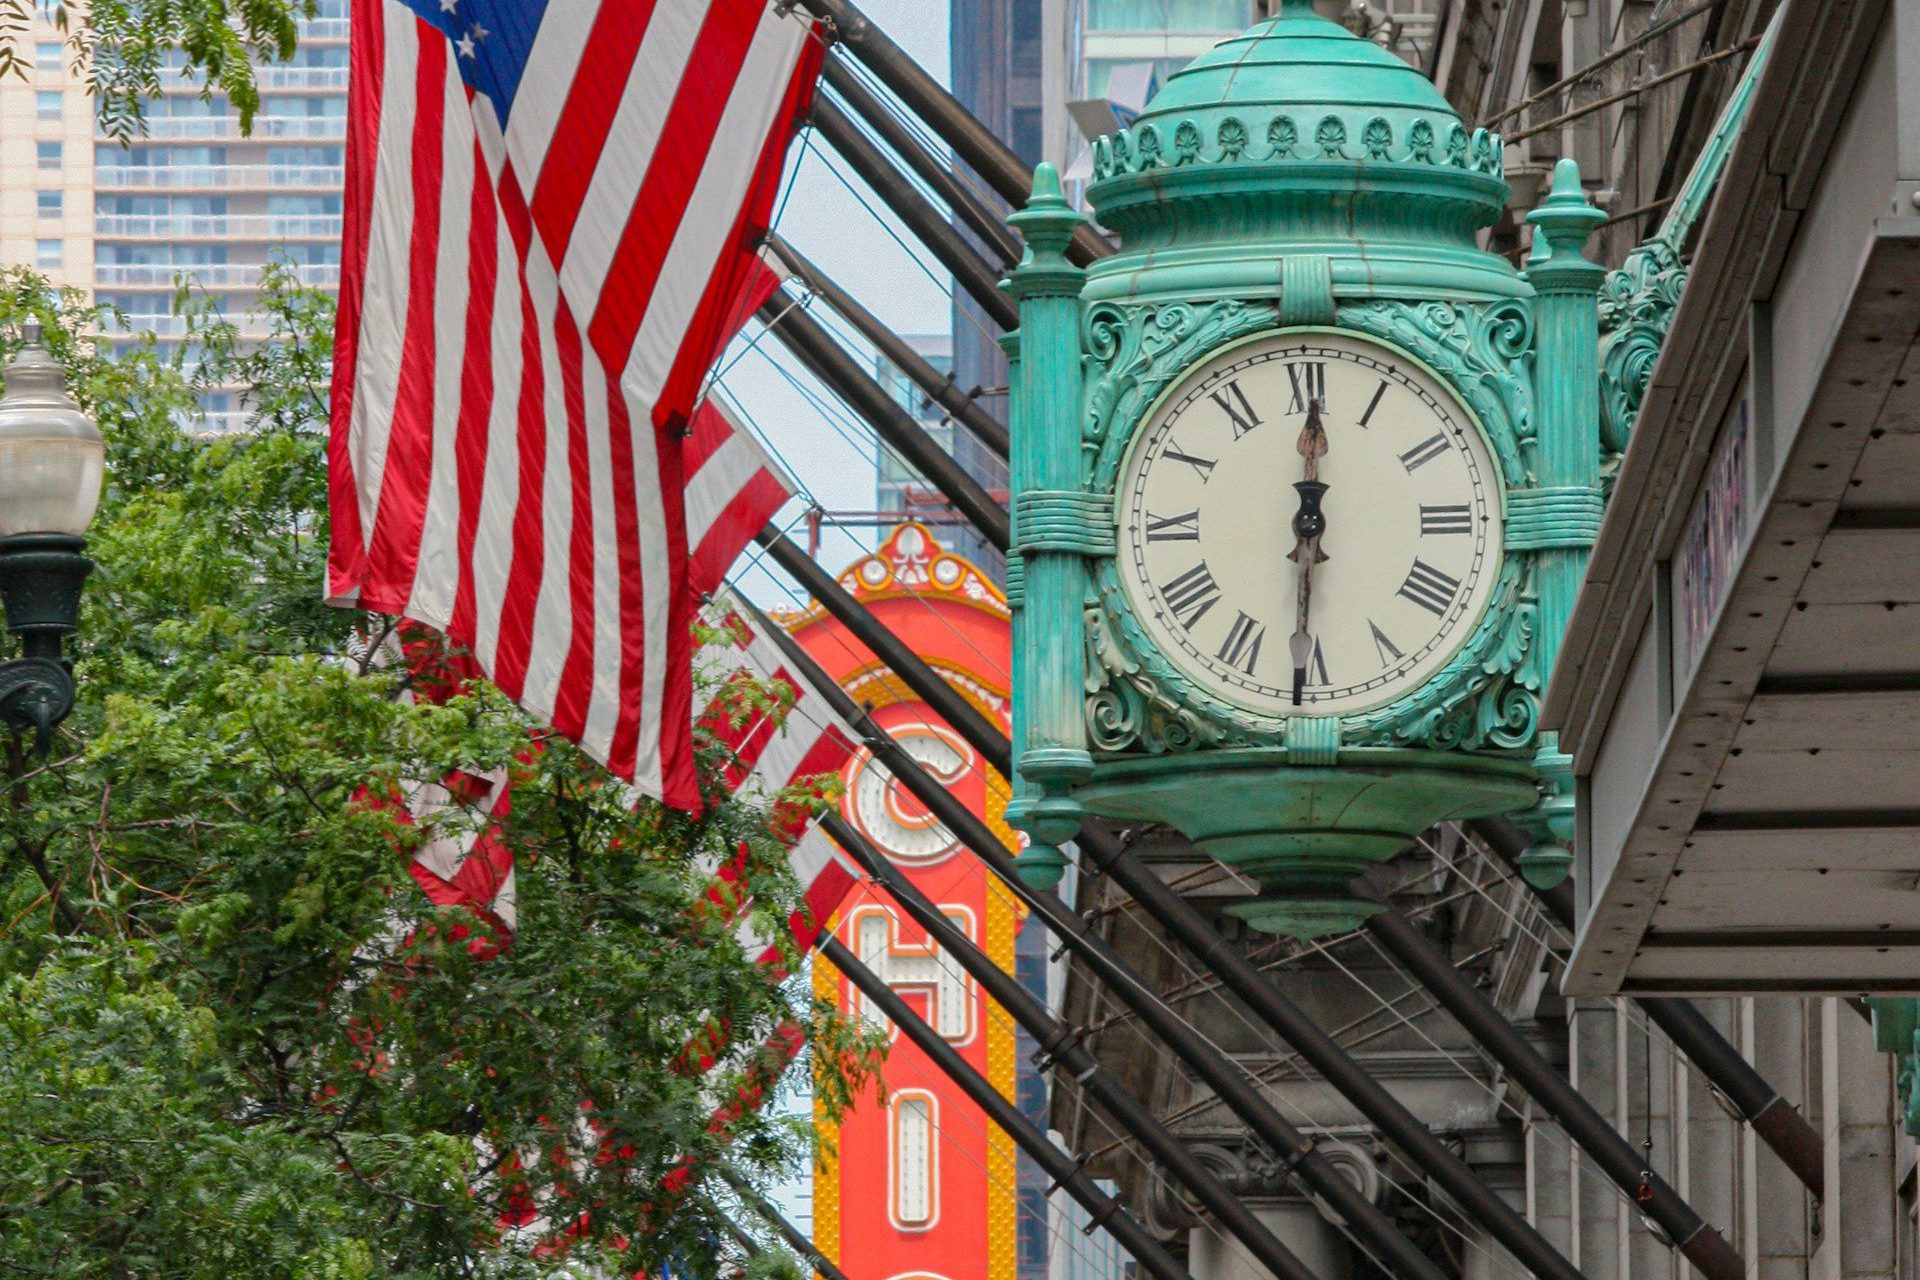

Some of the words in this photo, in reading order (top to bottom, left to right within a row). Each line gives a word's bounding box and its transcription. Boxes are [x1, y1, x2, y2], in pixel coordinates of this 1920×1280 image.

[1207, 378, 1264, 442] XI
[1282, 362, 1330, 416] XII
[1356, 378, 1391, 429] I
[1160, 435, 1219, 484] X
[1397, 428, 1454, 475] II
[1146, 507, 1200, 544] IX
[1419, 501, 1473, 538] III
[1158, 558, 1223, 634] VIII
[1395, 555, 1462, 619] IIII
[1213, 609, 1267, 677] VII
[1367, 618, 1407, 669] V
[845, 722, 977, 1280] CHI
